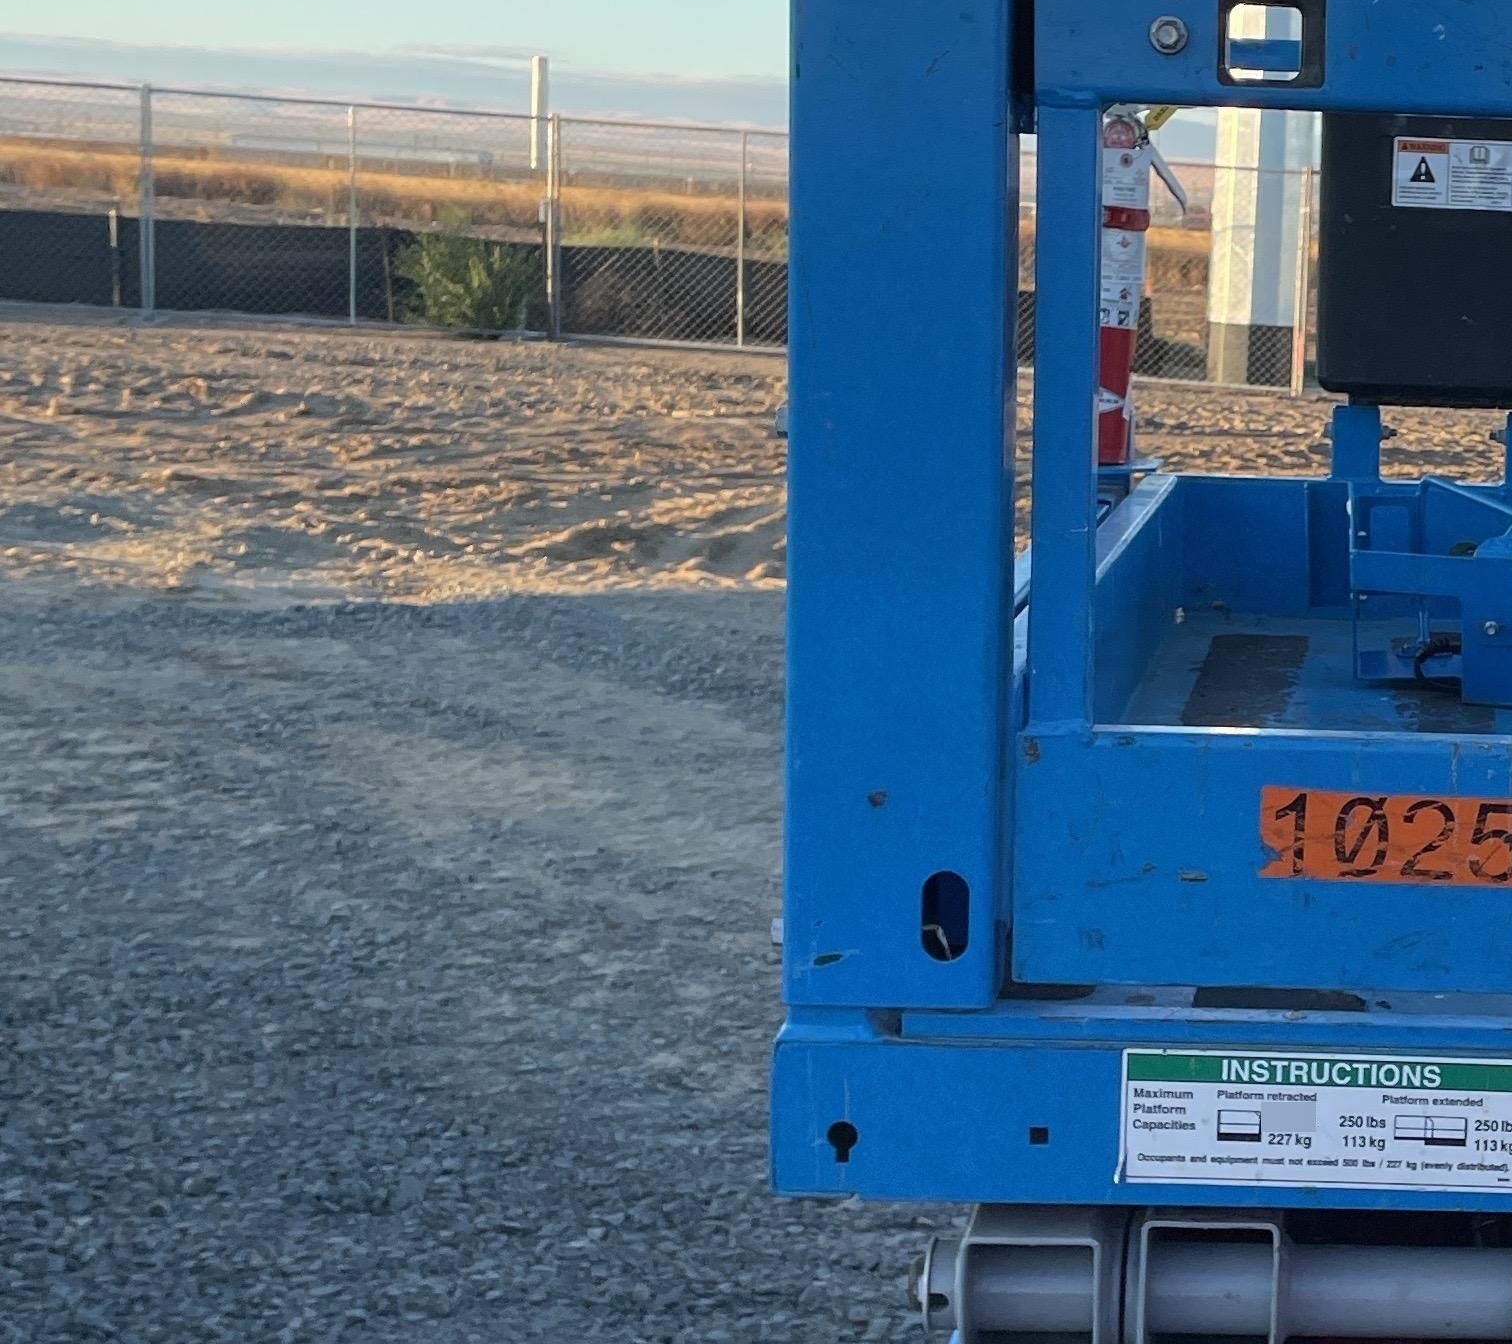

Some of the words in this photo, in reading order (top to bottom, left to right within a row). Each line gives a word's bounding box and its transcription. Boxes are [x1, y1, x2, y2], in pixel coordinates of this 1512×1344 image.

[1221, 1059, 1441, 1088] INSTRUCTIONS
[1133, 1088, 1194, 1099] Maximum
[1217, 1090, 1265, 1101] Platform
[1267, 1092, 1317, 1102] retracted
[1382, 1095, 1429, 1106] Platform
[1432, 1097, 1483, 1107] extended
[1133, 1103, 1187, 1115] Platform
[1132, 1119, 1196, 1132] Capacities
[1339, 1116, 1363, 1128] 250
[1366, 1116, 1386, 1129] lbs
[1475, 1120, 1499, 1132] 250
[1268, 1133, 1292, 1145] 227
[1295, 1134, 1312, 1149] kg
[1343, 1136, 1366, 1147] 113
[1369, 1136, 1386, 1151] kg
[1475, 1140, 1498, 1152] 113
[1137, 1153, 1186, 1165] Occupants
[1190, 1155, 1207, 1163] and
[1210, 1156, 1258, 1166] equipment
[1262, 1157, 1284, 1165] must
[1288, 1158, 1303, 1166] not
[1307, 1158, 1339, 1167] exceed
[1362, 1160, 1375, 1168] lbs
[1406, 1161, 1417, 1170] kg
